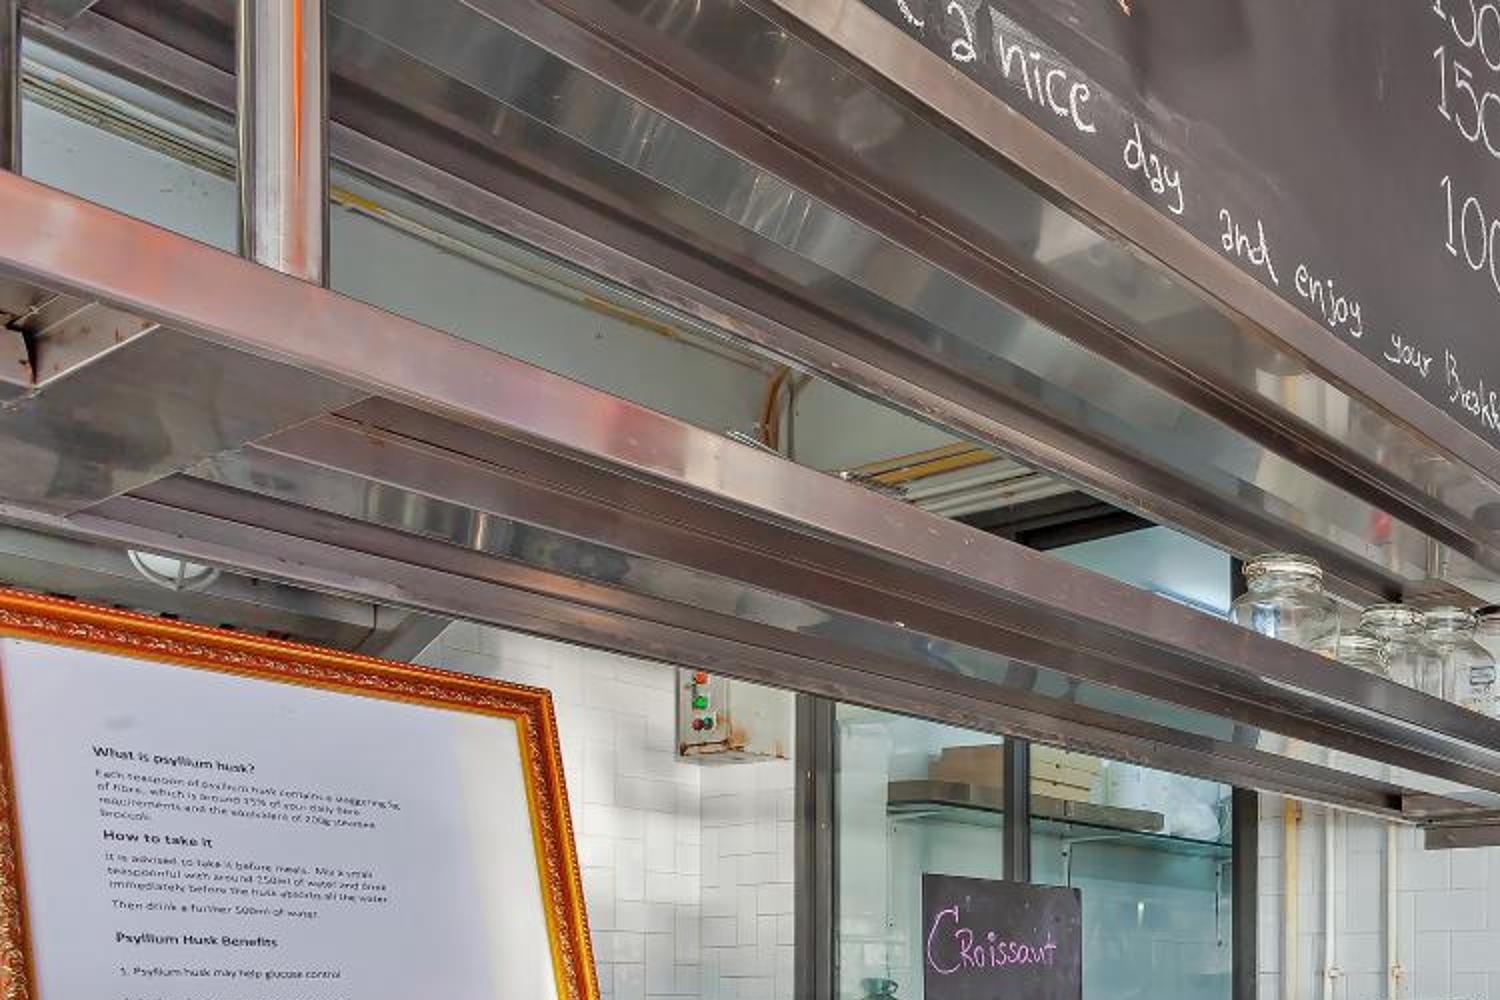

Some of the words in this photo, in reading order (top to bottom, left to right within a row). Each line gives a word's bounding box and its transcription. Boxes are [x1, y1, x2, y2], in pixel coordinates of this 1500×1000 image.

[1000, 34, 1096, 133] nice
[1123, 122, 1184, 215] day
[1220, 208, 1279, 285] and
[1295, 264, 1363, 337] enjoy
[1384, 333, 1432, 377] your
[93, 746, 134, 760] What
[139, 752, 149, 762] is
[217, 760, 255, 774] husk?
[103, 830, 139, 843] How
[144, 834, 161, 845] to
[165, 835, 198, 847] take
[202, 838, 213, 848] it
[116, 932, 179, 945] Psyllium
[183, 935, 219, 945] Husk
[221, 936, 279, 947] Benefits
